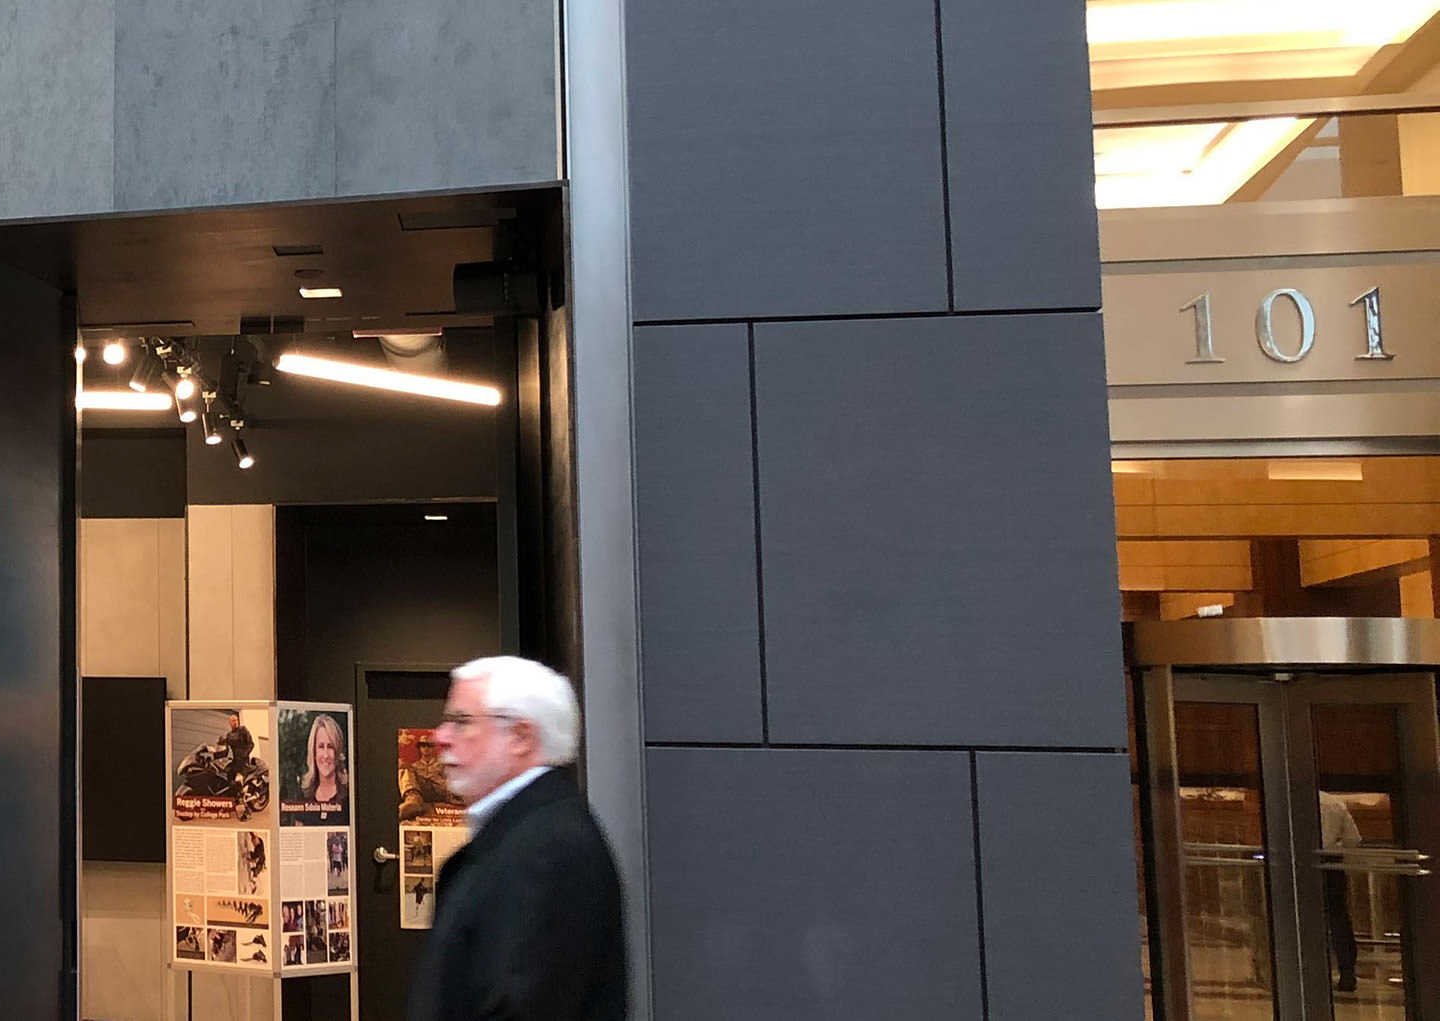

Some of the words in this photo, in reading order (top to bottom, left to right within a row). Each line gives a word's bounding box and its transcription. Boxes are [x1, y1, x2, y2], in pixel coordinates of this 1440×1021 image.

[1179, 286, 1397, 364] 101
[177, 798, 201, 809] Reggie
[202, 798, 233, 808] Showers
